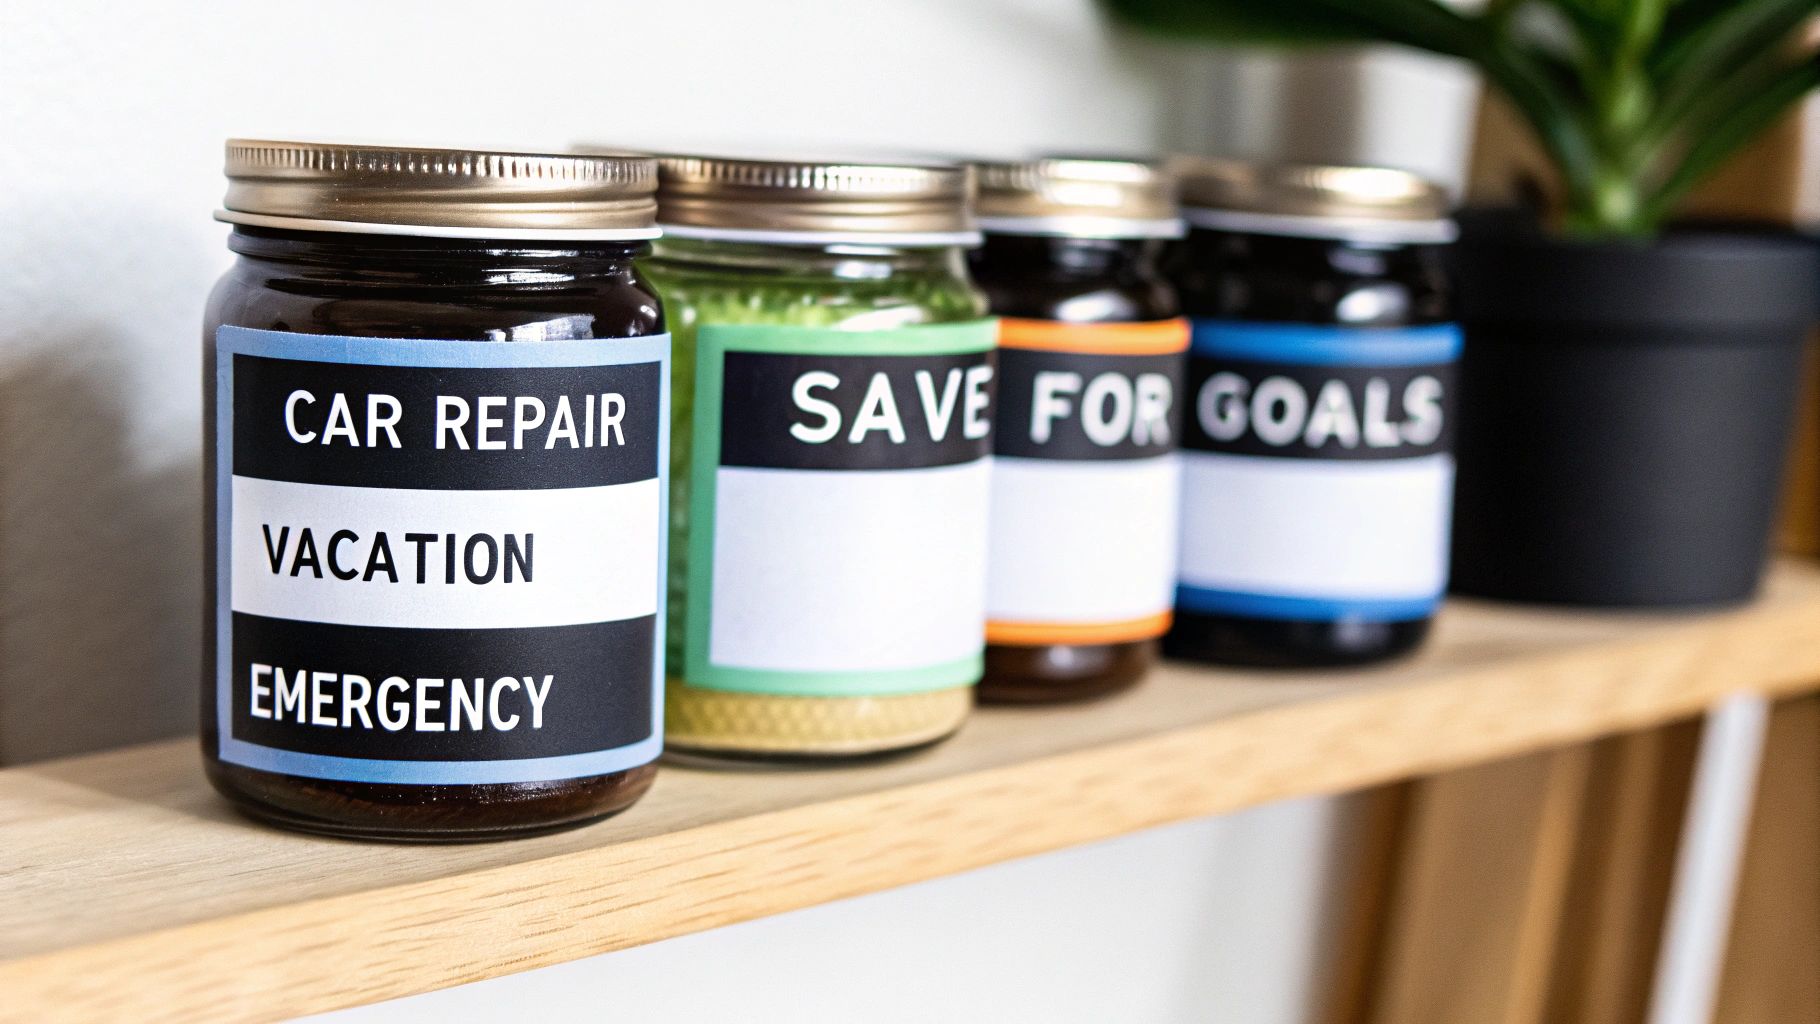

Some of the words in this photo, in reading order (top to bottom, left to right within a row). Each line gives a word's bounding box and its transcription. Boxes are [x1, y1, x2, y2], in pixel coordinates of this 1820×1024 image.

[284, 389, 403, 450] CAR
[434, 392, 627, 451] REPAIR
[789, 365, 994, 445] SAVE
[1030, 371, 1173, 447] FOR
[1197, 374, 1443, 448] GOALS
[262, 523, 534, 585] VACATION
[250, 663, 555, 732] EMERGENCY
